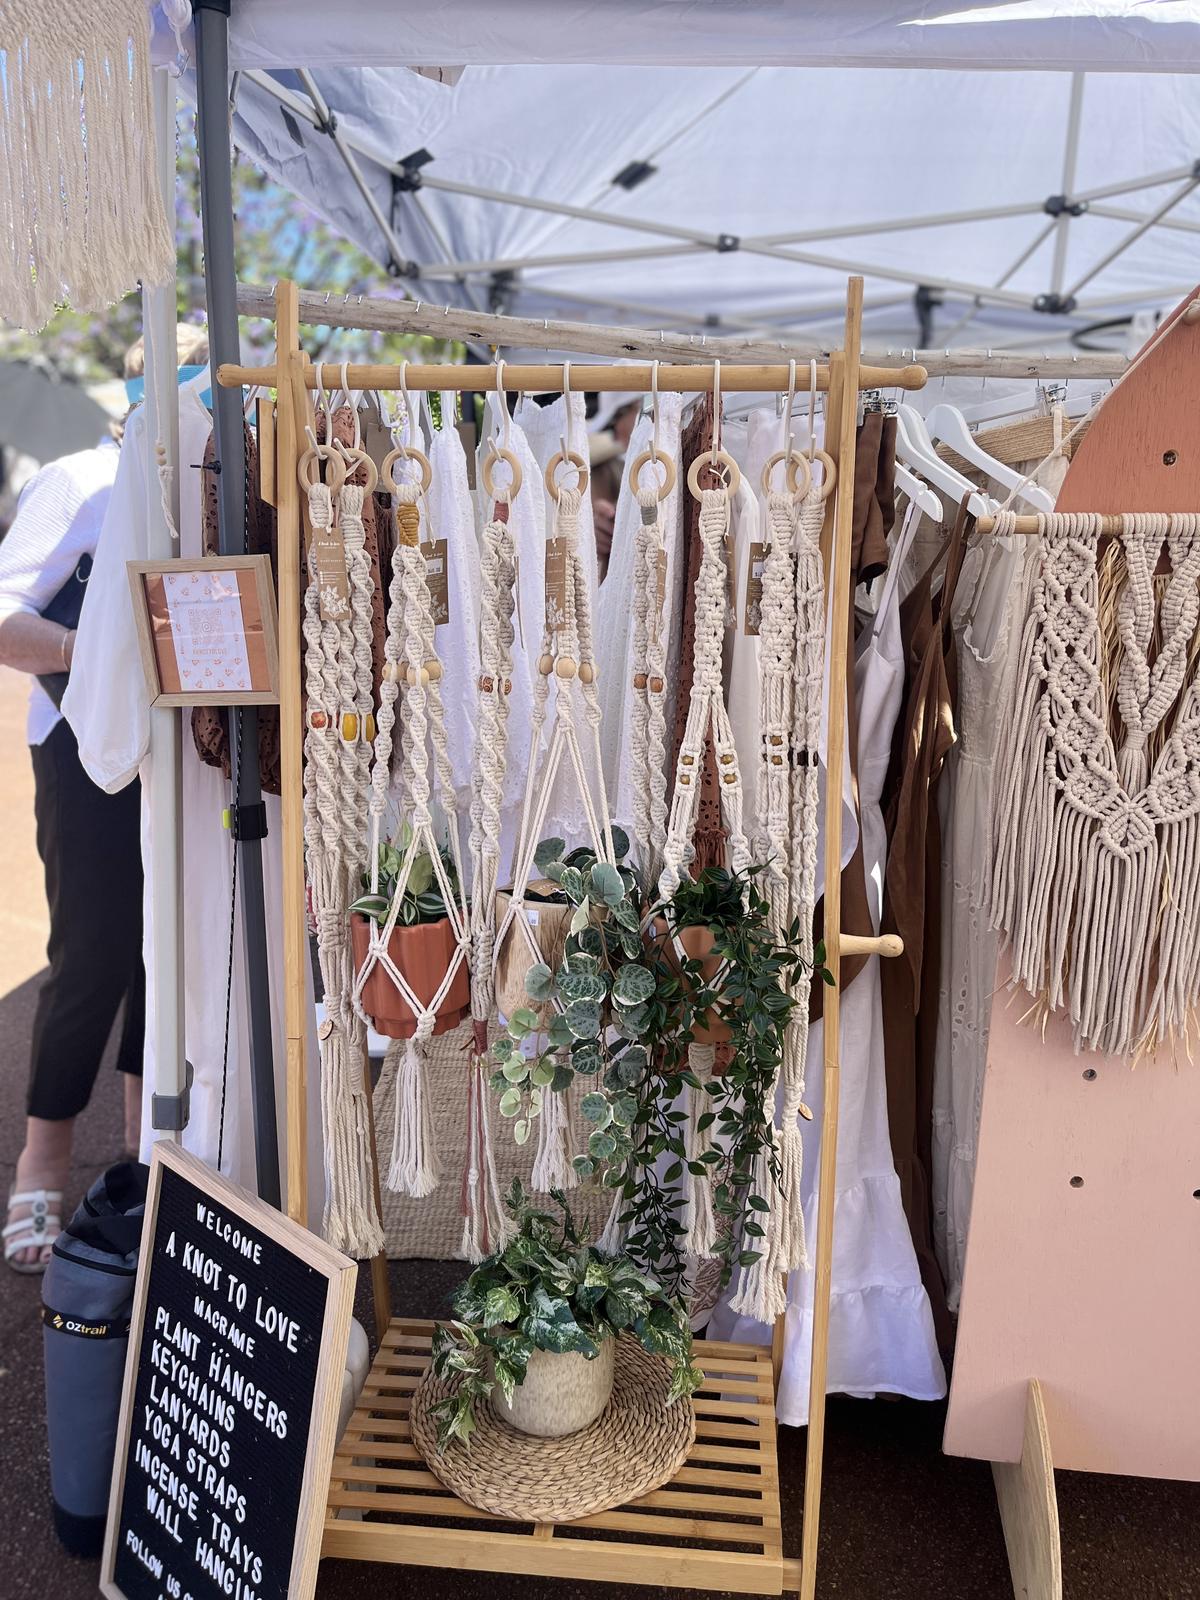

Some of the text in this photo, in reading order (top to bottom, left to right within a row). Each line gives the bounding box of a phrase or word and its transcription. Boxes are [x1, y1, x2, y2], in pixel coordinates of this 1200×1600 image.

[196, 1202, 263, 1265] WELCOME
[65, 1320, 107, 1335] OZtrail
[165, 1231, 301, 1354] A KNOT TO LOVE
[193, 1295, 256, 1359] MACRAME
[150, 1338, 236, 1433] KEYCHAINS
[154, 1305, 288, 1440] PLANT HANGERS
[144, 1404, 247, 1524] YOGA STRAPS
[149, 1374, 231, 1468] LANYARDS
[135, 1438, 263, 1585] INCENSE TRAYS
[146, 1484, 184, 1544] WALL
[126, 1529, 181, 1599] FOLLOW US
